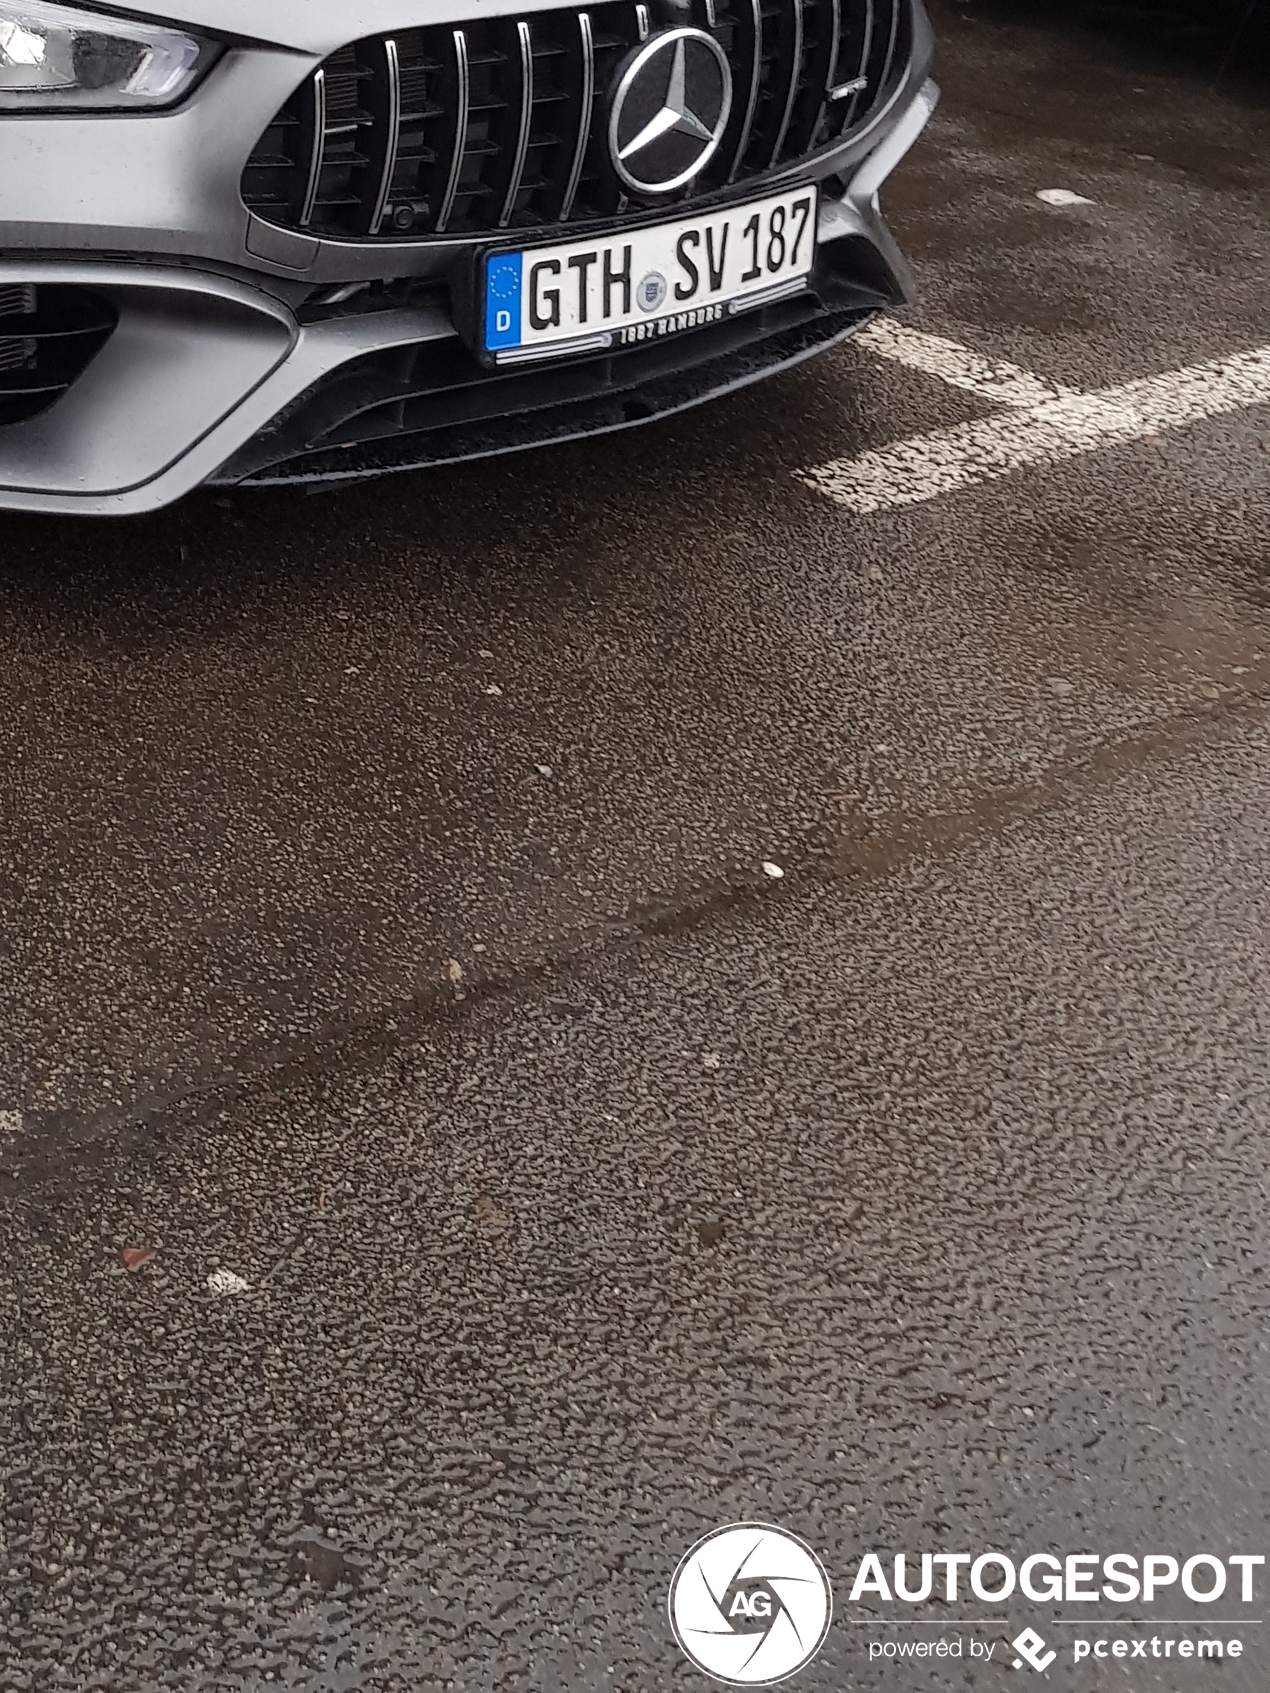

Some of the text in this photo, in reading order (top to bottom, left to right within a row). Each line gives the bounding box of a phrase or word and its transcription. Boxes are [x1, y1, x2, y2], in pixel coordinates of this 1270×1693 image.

[529, 197, 812, 331] GTH SV 187
[496, 310, 511, 332] D
